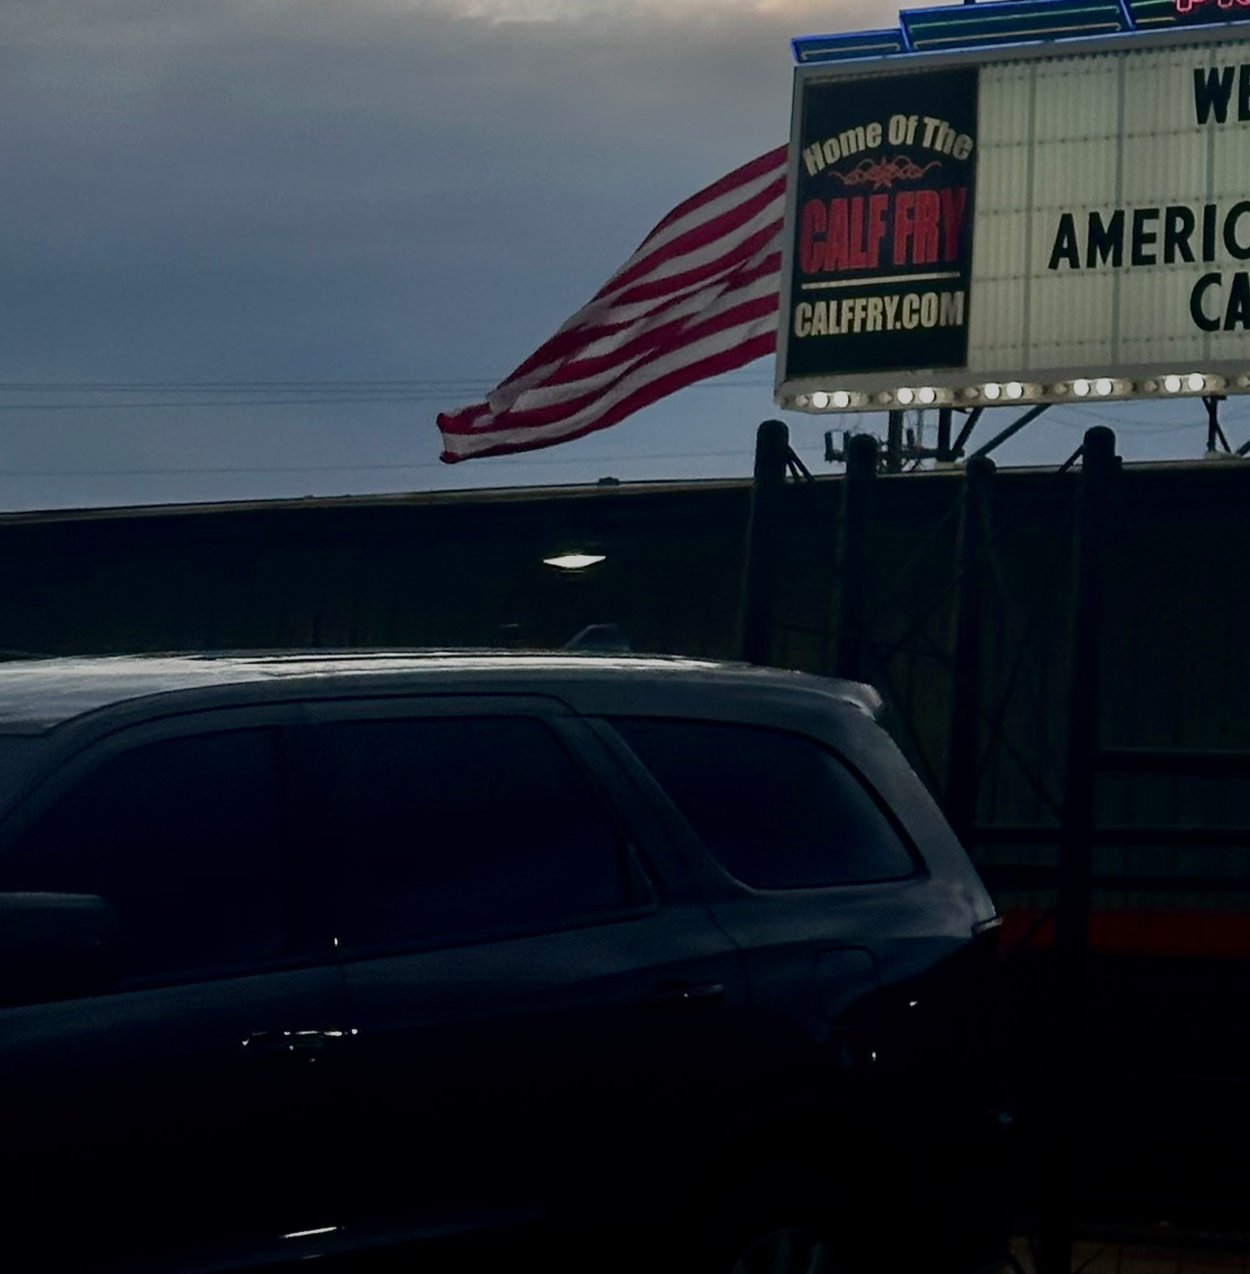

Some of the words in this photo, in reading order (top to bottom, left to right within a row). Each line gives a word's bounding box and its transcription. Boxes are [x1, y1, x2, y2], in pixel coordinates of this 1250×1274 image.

[802, 121, 883, 177] Home
[888, 113, 919, 146] Of
[923, 116, 974, 161] The
[800, 193, 889, 274] CALF
[893, 187, 967, 266] FRY
[794, 290, 965, 338] CALFFRY.COM
